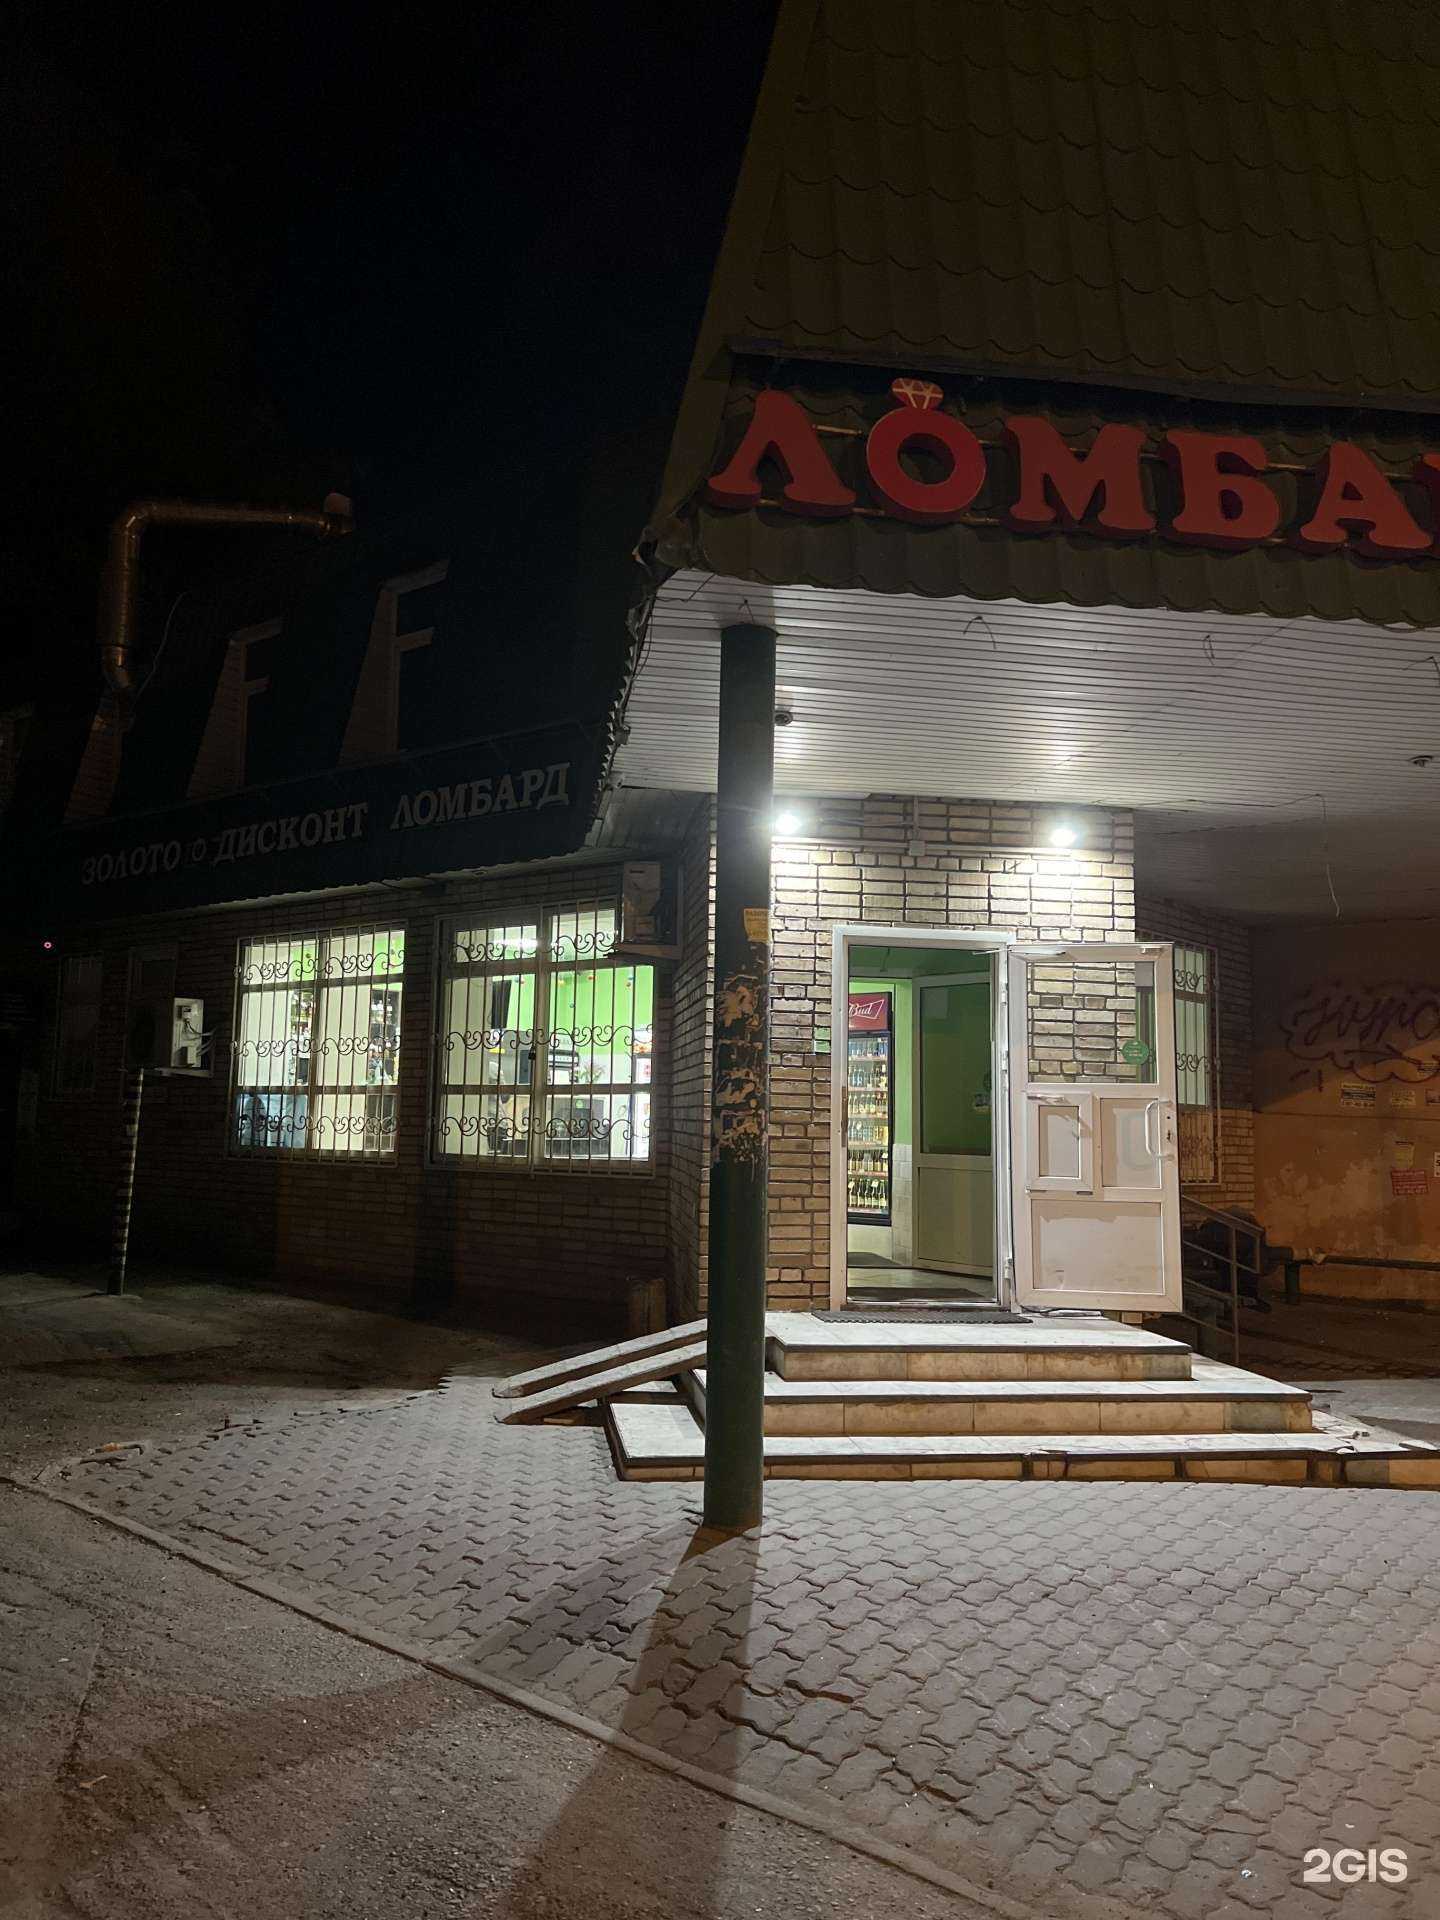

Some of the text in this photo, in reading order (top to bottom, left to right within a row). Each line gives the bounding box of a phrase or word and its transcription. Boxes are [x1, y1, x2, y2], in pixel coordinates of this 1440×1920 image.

[707, 387, 1440, 555] ЛОМБА
[80, 762, 571, 886] ЗОЛОТО ДИСКОНТ ЛОМБАРД
